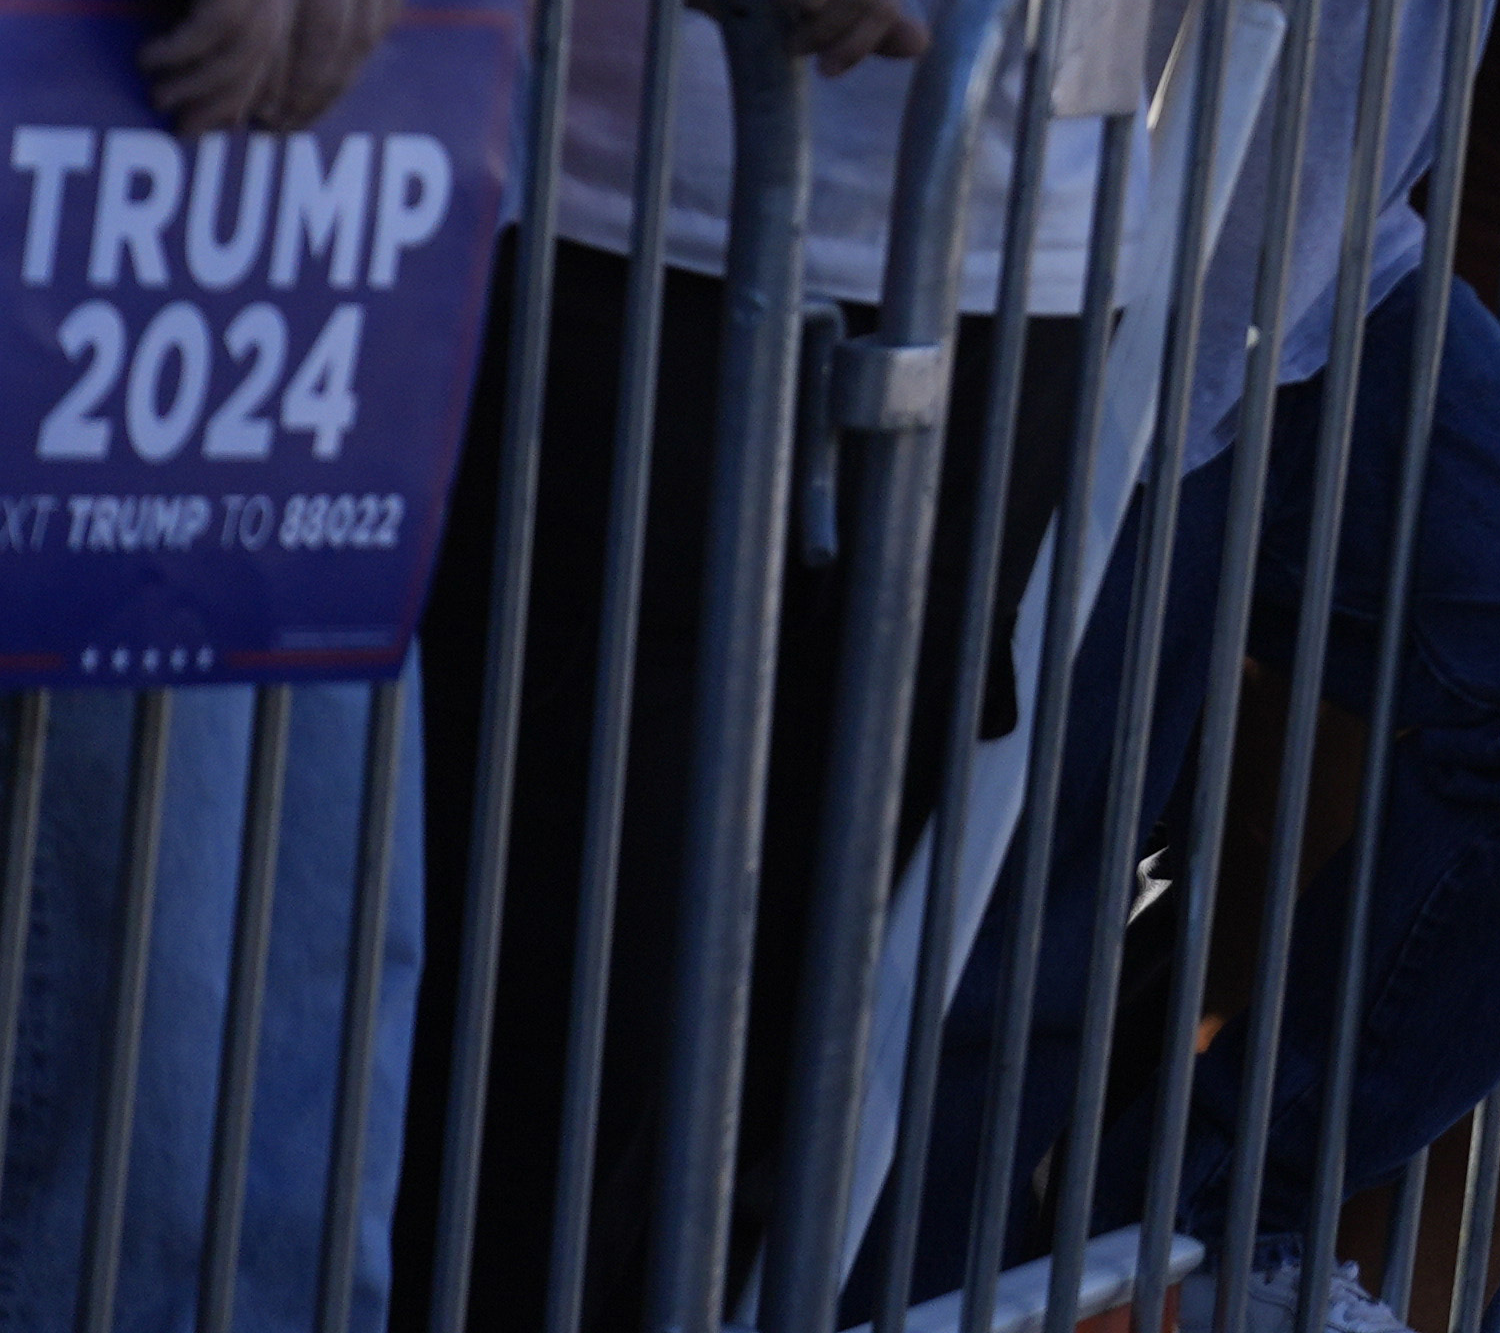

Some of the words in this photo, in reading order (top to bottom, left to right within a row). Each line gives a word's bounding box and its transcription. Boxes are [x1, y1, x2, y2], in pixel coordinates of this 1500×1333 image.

[11, 124, 453, 291] TRUMP
[36, 298, 365, 463] 2024
[66, 493, 212, 553] TRUMP
[221, 493, 275, 552] TO
[277, 492, 404, 550] 88022
